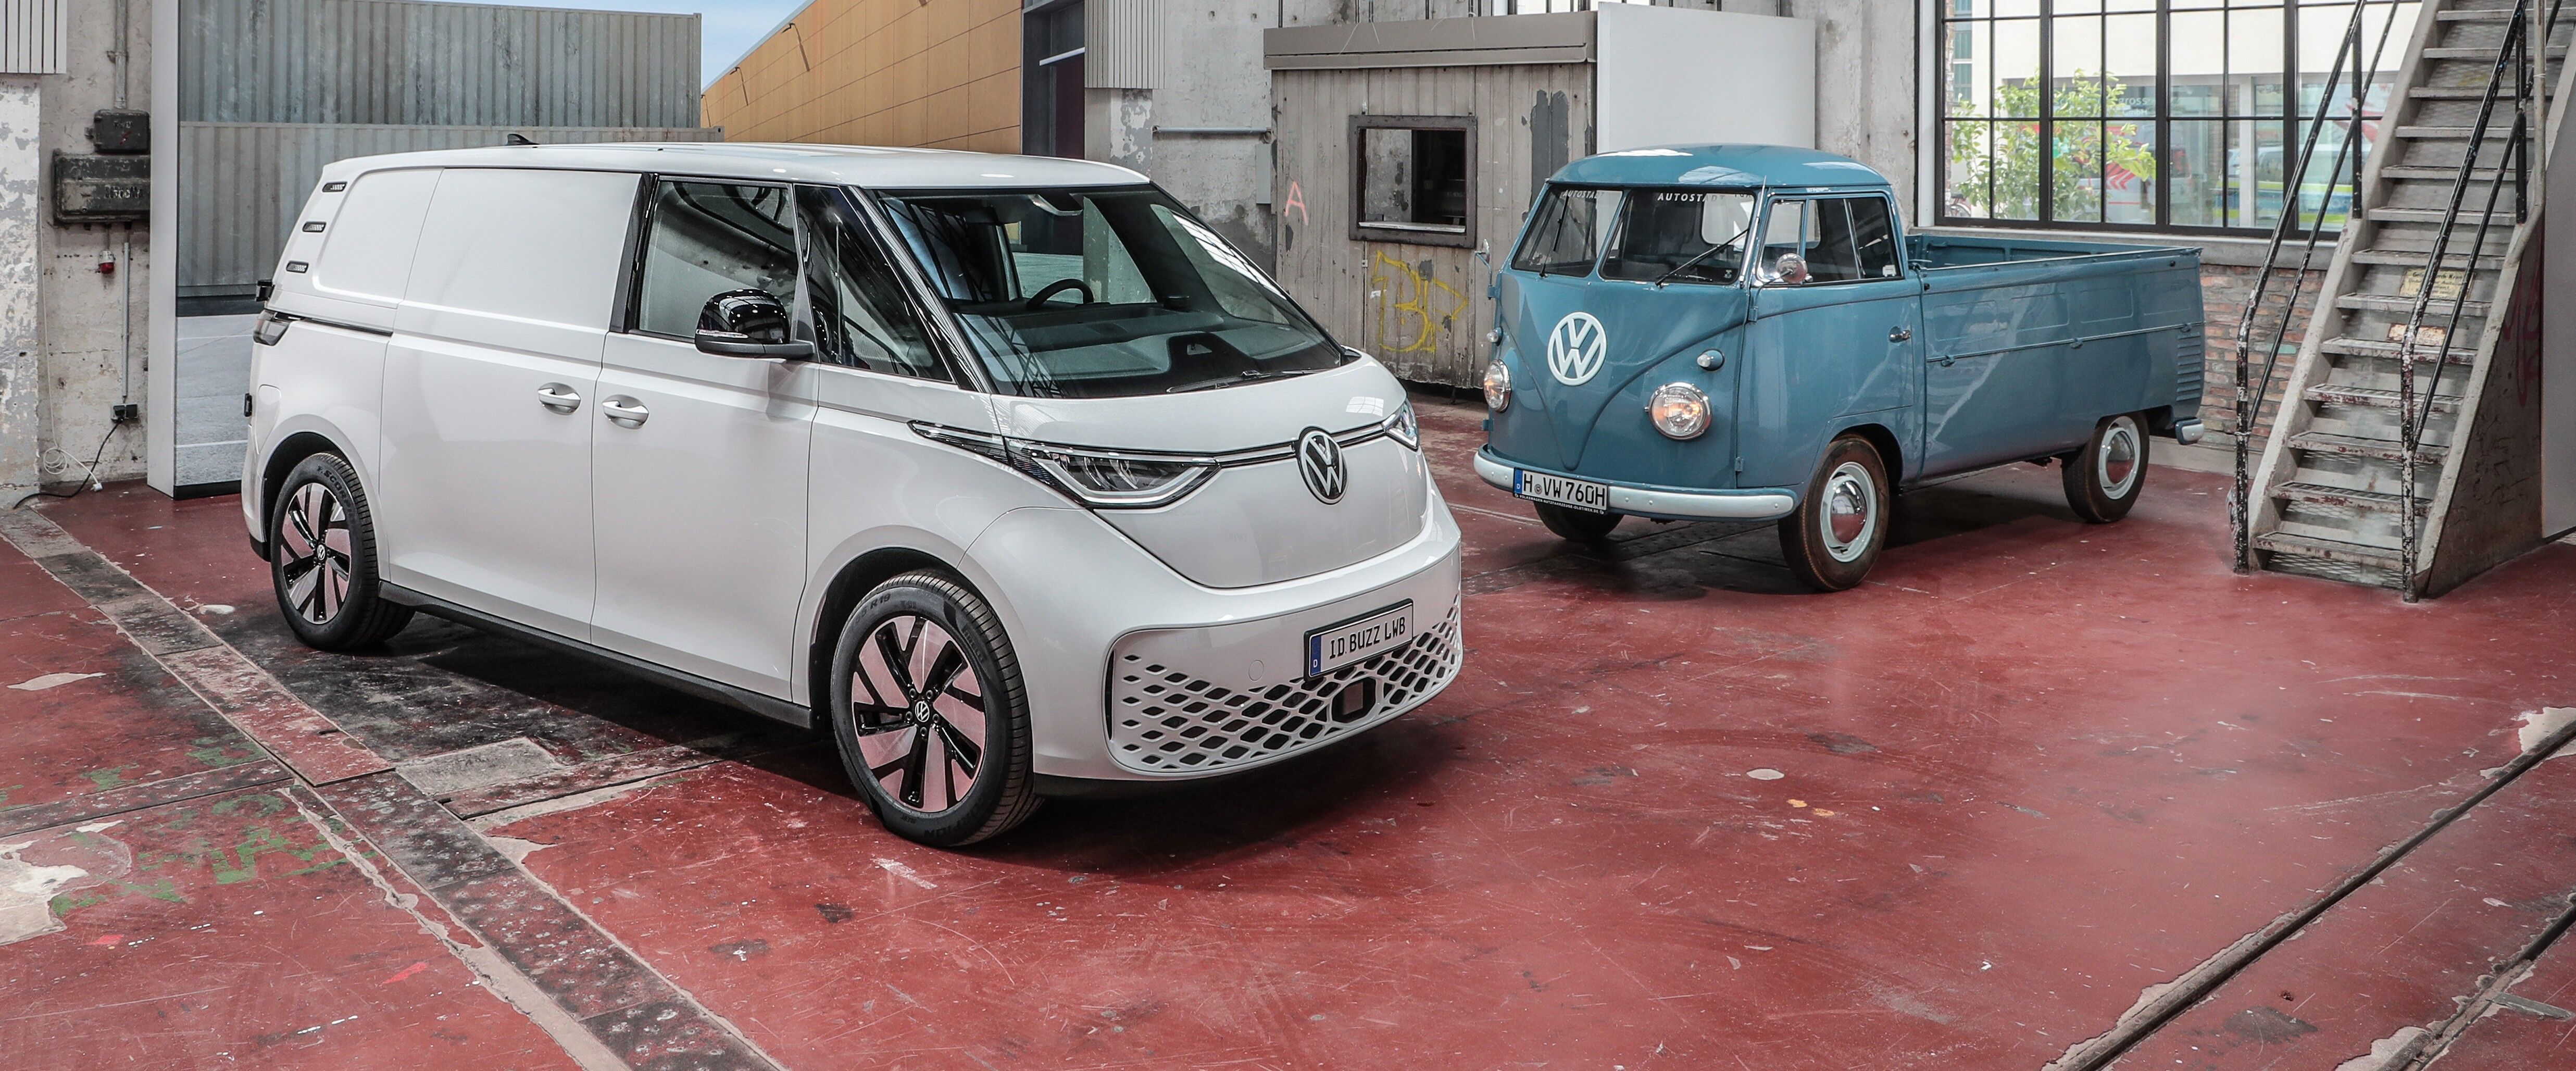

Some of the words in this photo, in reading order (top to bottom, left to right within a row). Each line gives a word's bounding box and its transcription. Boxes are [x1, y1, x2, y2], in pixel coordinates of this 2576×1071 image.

[1285, 181, 1308, 226] A
[1657, 193, 1725, 202] AUTOSTADT
[1547, 312, 1607, 386] VW
[1300, 431, 1344, 503] VW
[1523, 474, 1533, 493] H
[1543, 477, 1562, 498] VW
[1566, 481, 1605, 507] 760H
[1312, 658, 1318, 668] D
[1349, 625, 1380, 653] BUZZ
[1384, 616, 1405, 641] LWB
[915, 701, 930, 723] VW
